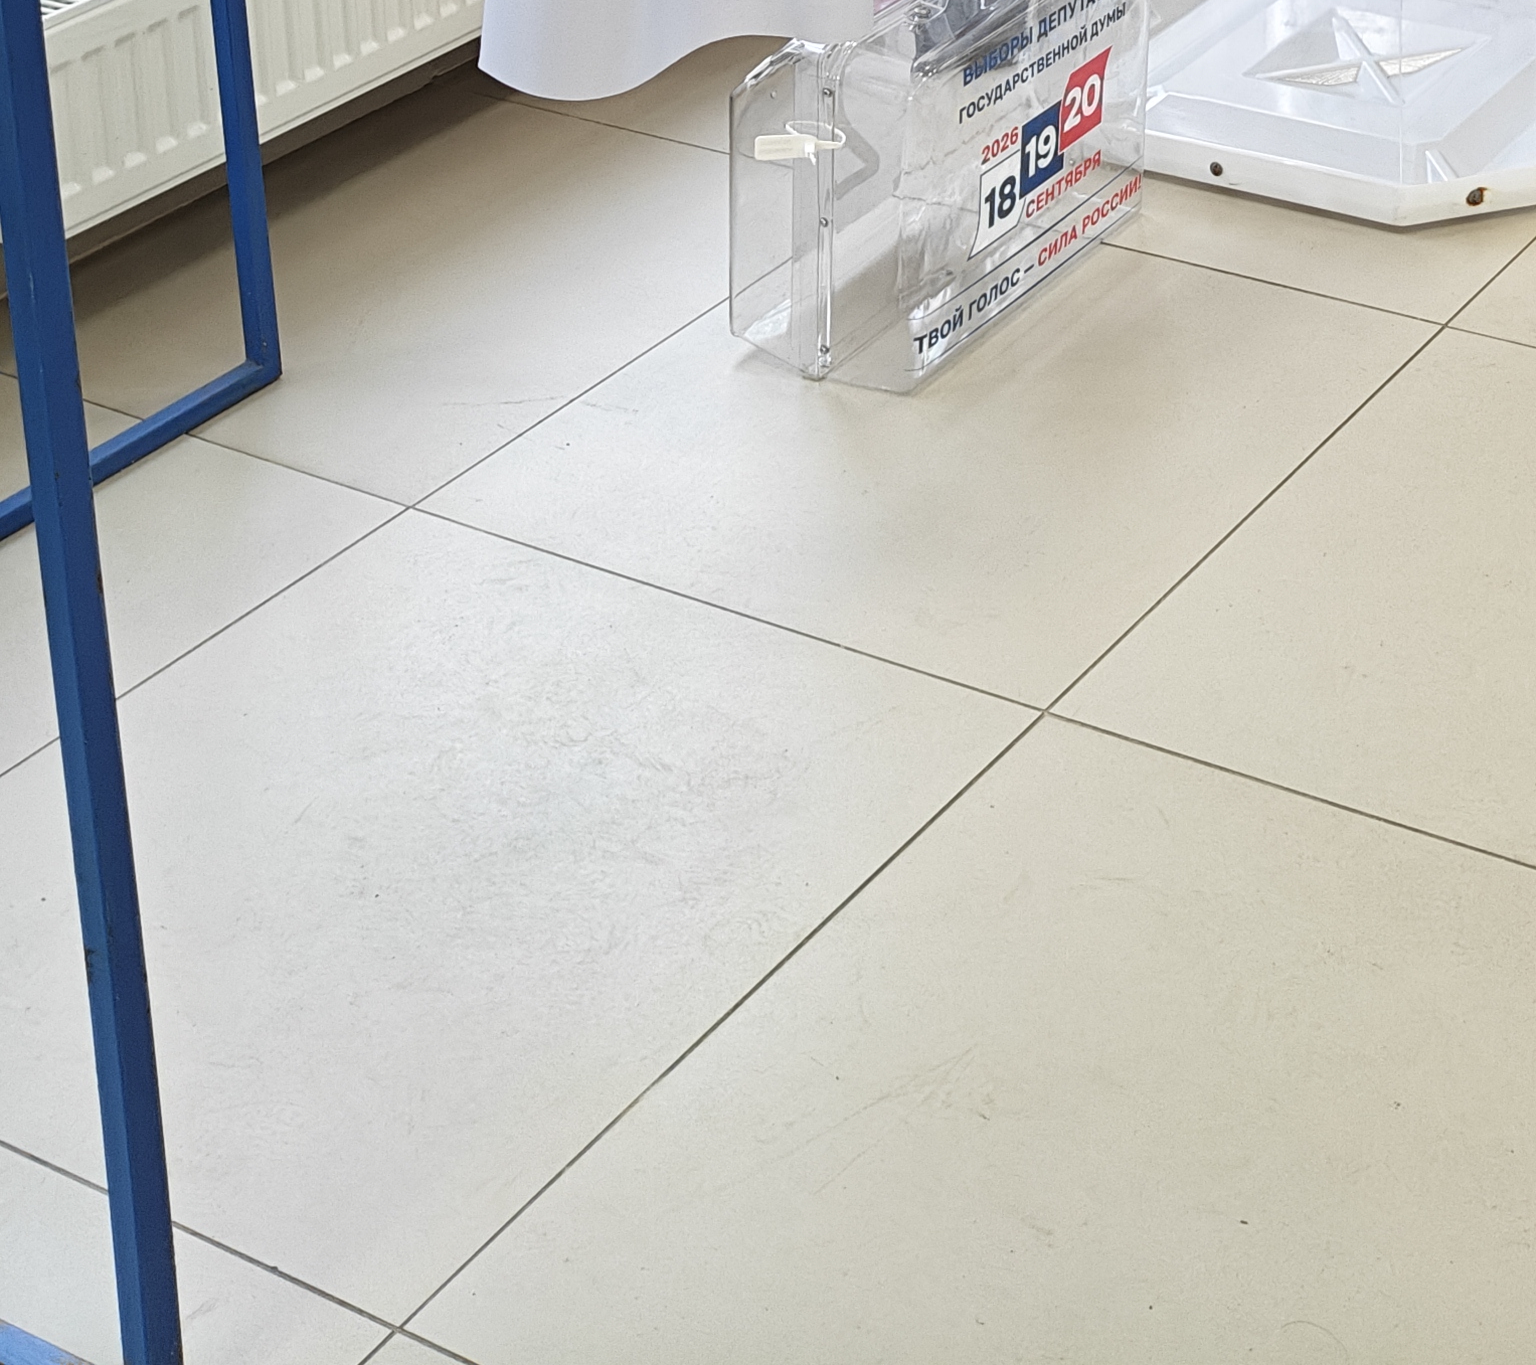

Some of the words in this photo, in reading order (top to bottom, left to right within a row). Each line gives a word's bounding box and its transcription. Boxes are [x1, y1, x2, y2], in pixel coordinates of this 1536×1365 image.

[959, 24, 1088, 124] ГОСУДАРСТВЕННОЙ
[1090, 2, 1127, 42] ДУМЫ
[963, 26, 1033, 87] ВЫБОРЫ
[981, 126, 1019, 165] 2026
[984, 175, 1017, 228] 18
[1025, 125, 1056, 178] 19
[1063, 73, 1101, 133] 20
[1025, 149, 1102, 218] СЕНТЯБРЯ
[913, 306, 964, 354] ТВОЙ
[968, 268, 1021, 320] ГОЛОС
[1038, 225, 1078, 267] СИЛА
[1081, 173, 1142, 235] РОССИИ!
